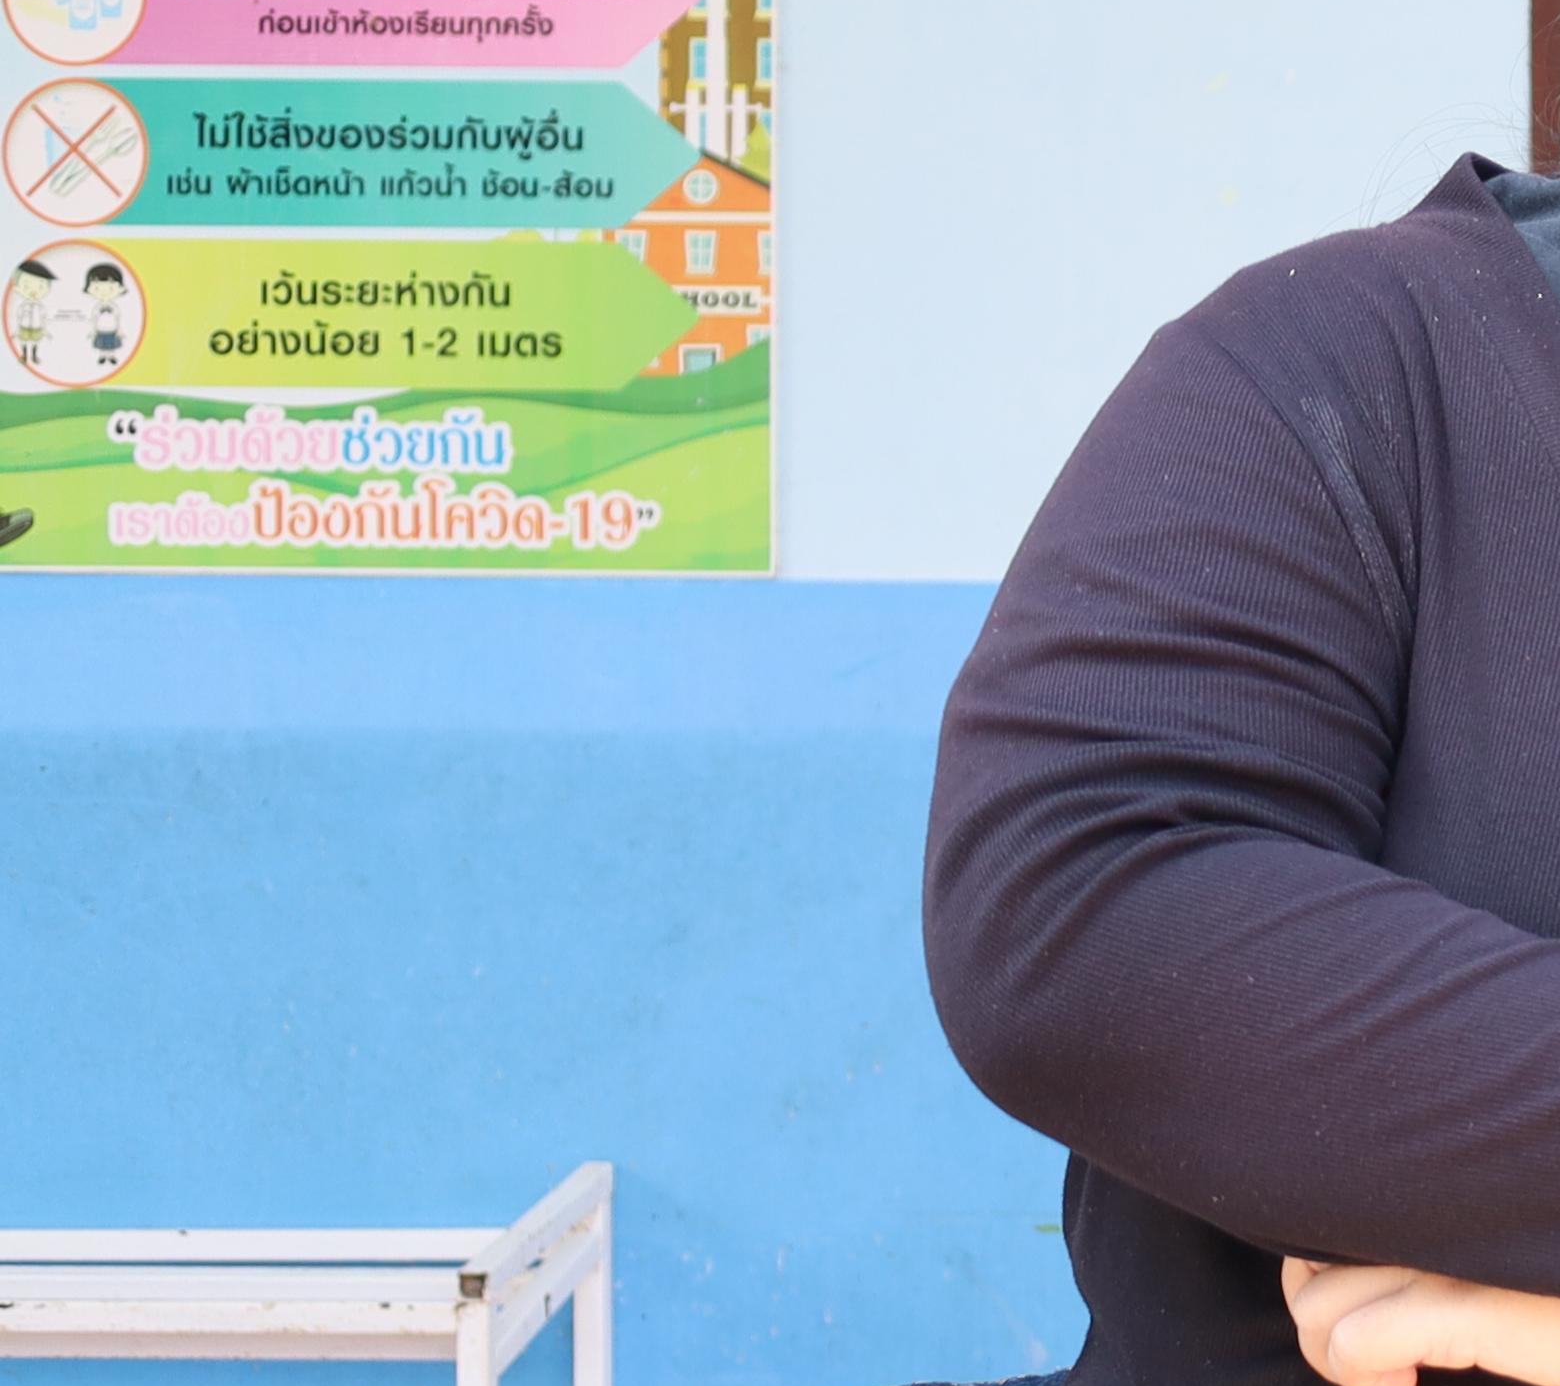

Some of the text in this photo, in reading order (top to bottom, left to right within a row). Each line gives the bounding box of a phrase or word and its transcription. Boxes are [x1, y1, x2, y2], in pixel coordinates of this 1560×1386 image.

[257, 4, 554, 43] ก่อนเข้าห้องเรียนทุกครั้ง
[192, 107, 584, 161] ไม่ใช้สิ่งของร่วมกับผู้อื่น
[166, 162, 614, 198] เช่น ผ้าเช็ดหน้า แก้วน้ำ ช้อน-ส้อม
[260, 270, 512, 307] เว้นระยะห่างกัน
[208, 319, 563, 358] อย่างน้อย 1-2 เมตร
